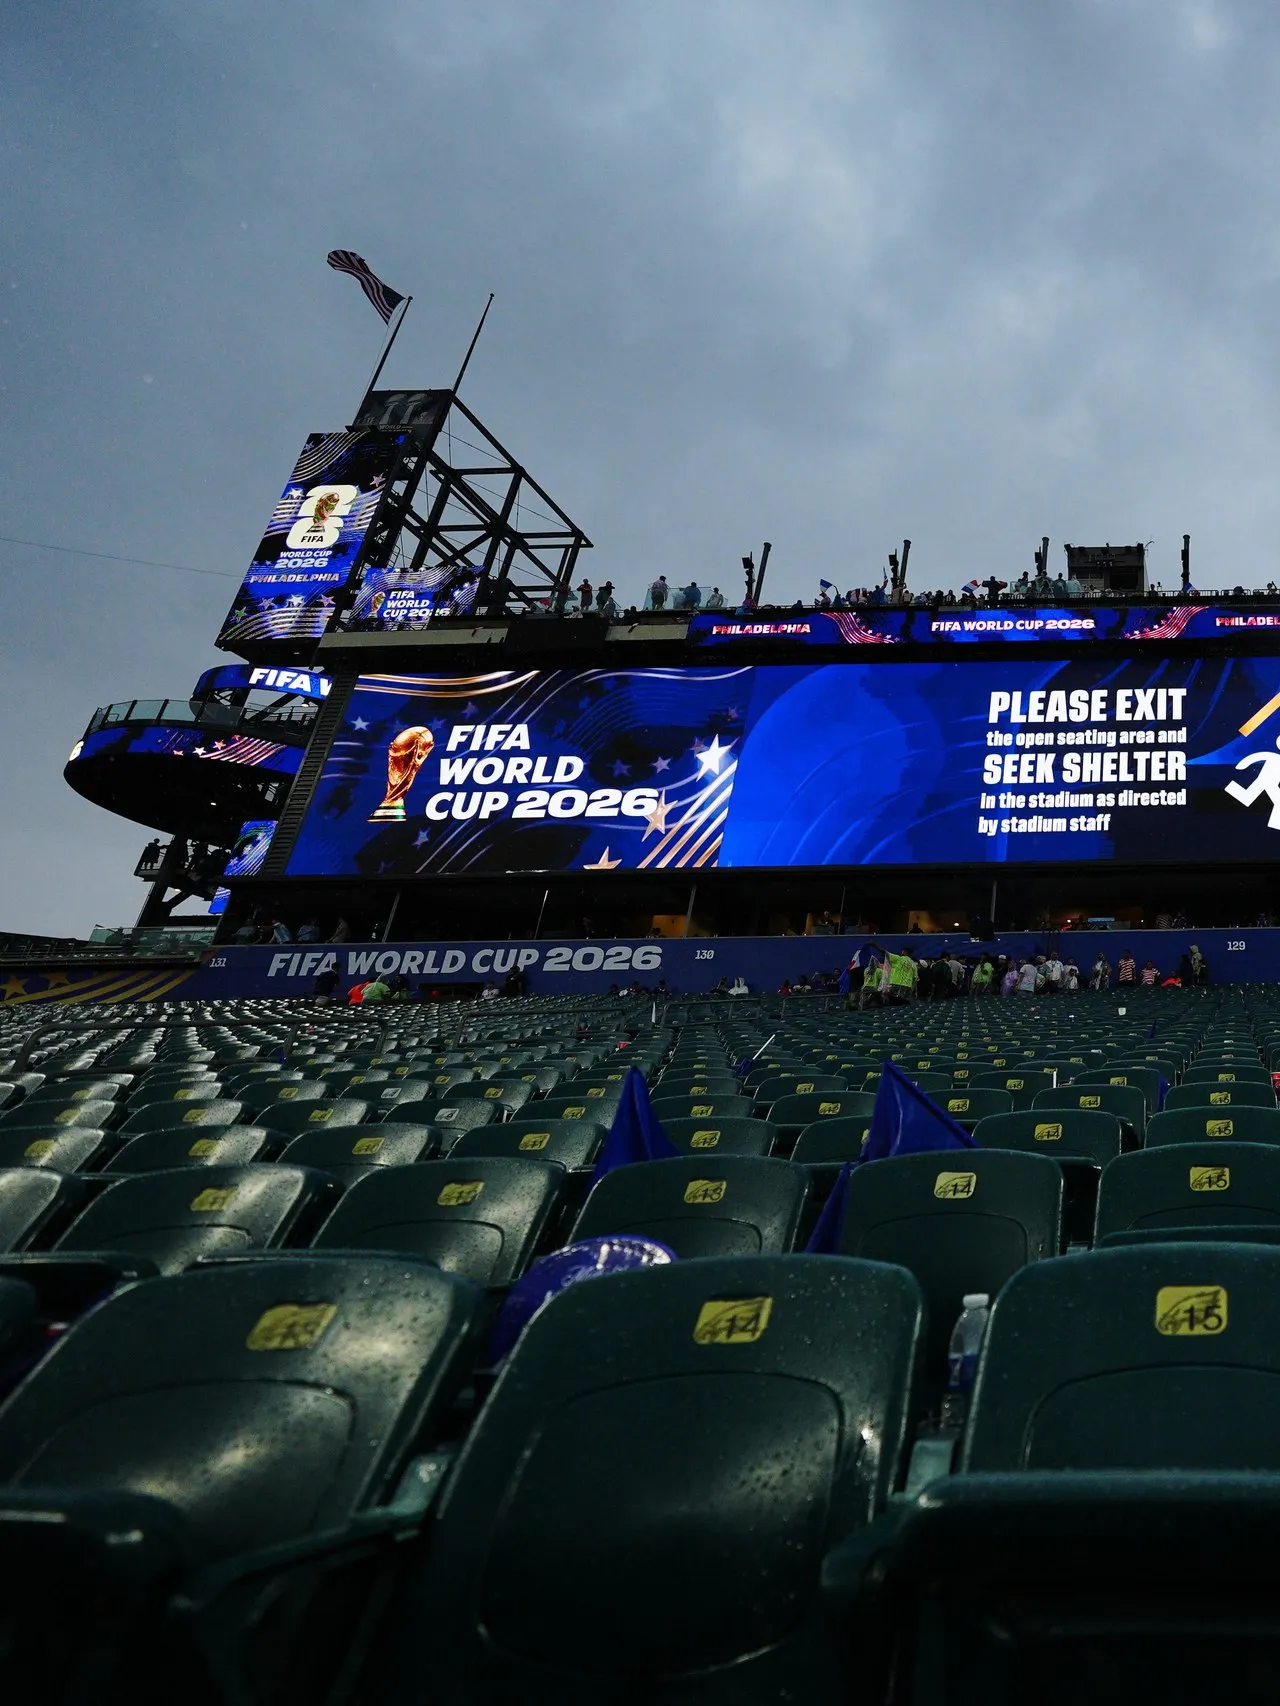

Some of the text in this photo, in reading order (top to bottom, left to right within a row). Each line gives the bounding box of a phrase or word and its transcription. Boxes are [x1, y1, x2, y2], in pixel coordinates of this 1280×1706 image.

[301, 535, 324, 543] FIFA
[274, 558, 329, 569] 2026
[249, 573, 340, 583] PHILADELPHIA
[389, 590, 415, 599] FIFA
[387, 599, 430, 608] WORLD
[383, 609, 408, 617] CUP
[712, 623, 811, 635] PHILADELPHIA
[931, 619, 1095, 632] FIFA WORLD CUP 2026
[249, 668, 312, 691] FIFA
[988, 688, 1187, 724] PLEASE EXIT
[445, 723, 532, 752] FIFA
[986, 727, 1187, 749] the open seating area and
[439, 755, 584, 786] WORLD
[983, 750, 1187, 784] SEEK SHELTER
[425, 788, 660, 822] CUP 2026
[980, 788, 1187, 809] in the stadium as directed
[978, 814, 1112, 836] by stadium staff
[1226, 941, 1246, 951] 129
[209, 957, 227, 968] 131
[267, 945, 662, 977] FIFA WORLD CUP 2026
[694, 950, 715, 960] 130
[1045, 1127, 1060, 1138] 14
[1217, 1124, 1231, 1135] 15
[952, 1181, 972, 1196] 14
[1207, 1173, 1228, 1189] 15
[702, 1186, 723, 1201] 13
[1187, 1302, 1223, 1332] 15
[727, 1313, 762, 1341] 14
